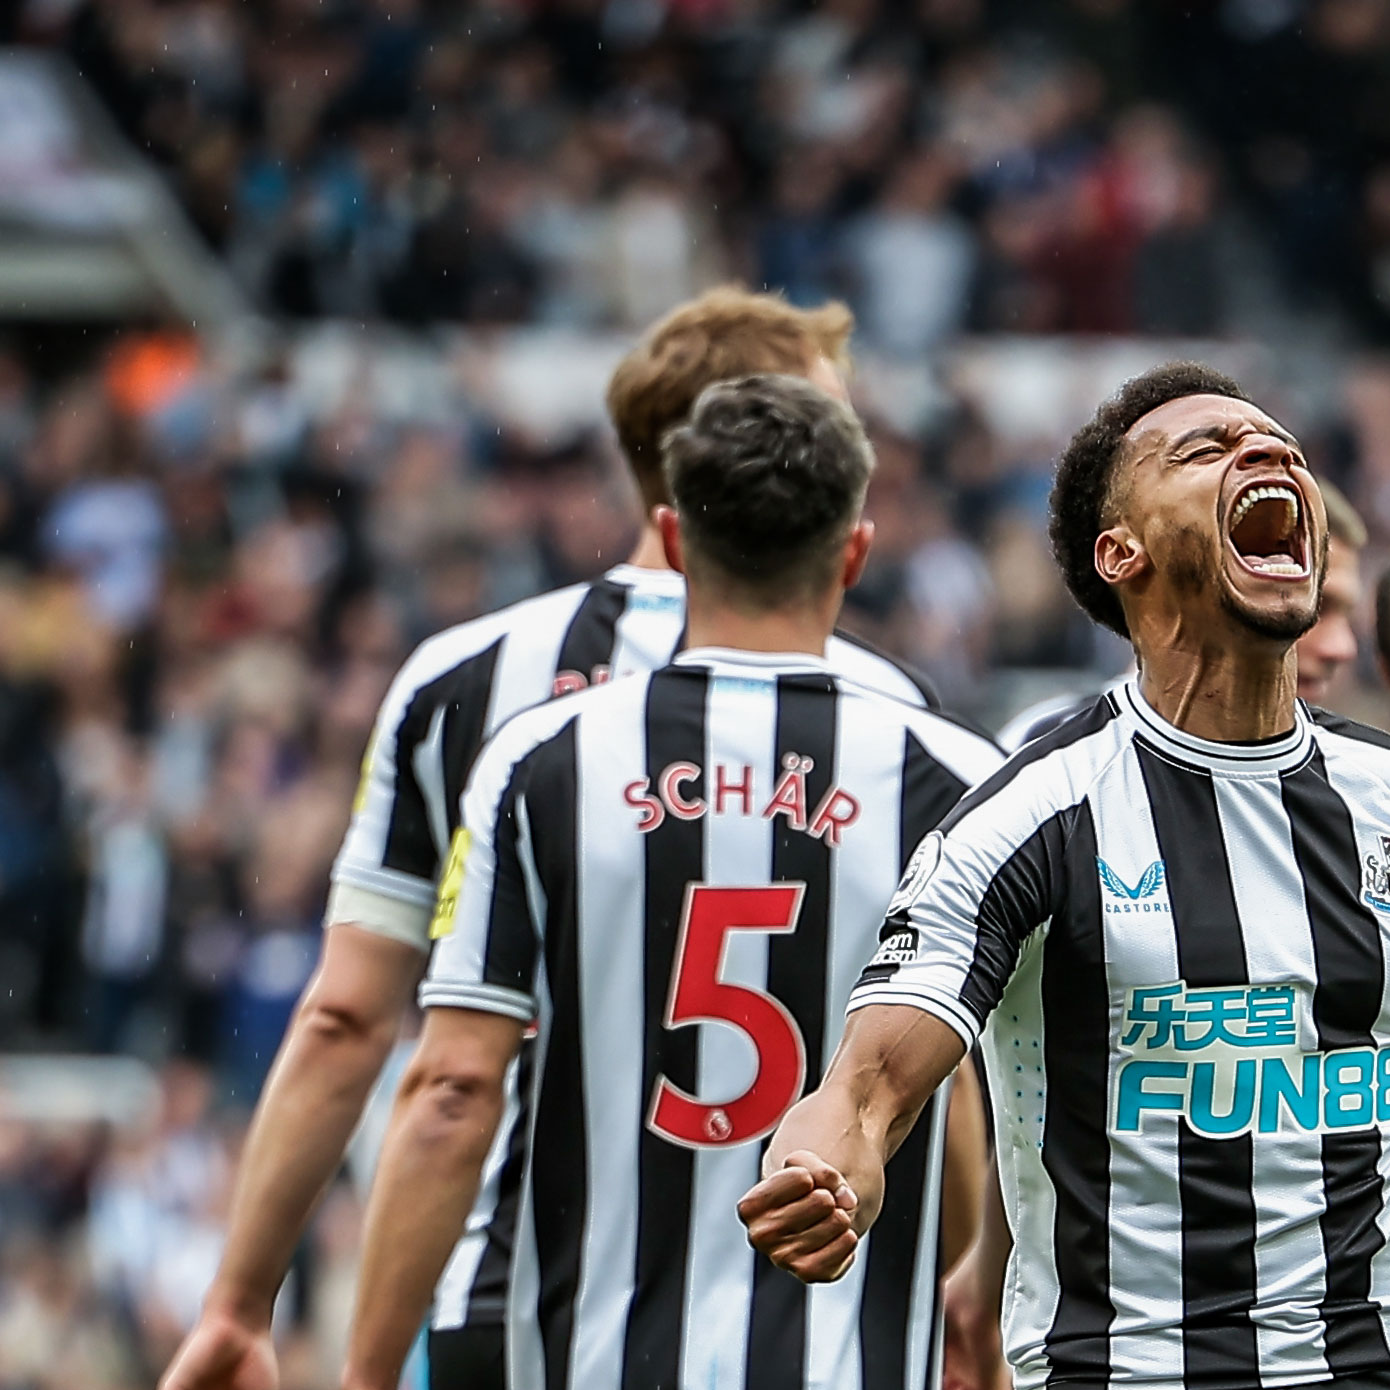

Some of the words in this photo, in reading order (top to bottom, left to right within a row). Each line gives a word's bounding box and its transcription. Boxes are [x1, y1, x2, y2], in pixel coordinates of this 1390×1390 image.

[622, 752, 861, 848] SCHÄR
[1105, 902, 1170, 913] CASTORE
[645, 881, 807, 1150] 5
[1121, 983, 1297, 1051] 乐天堂
